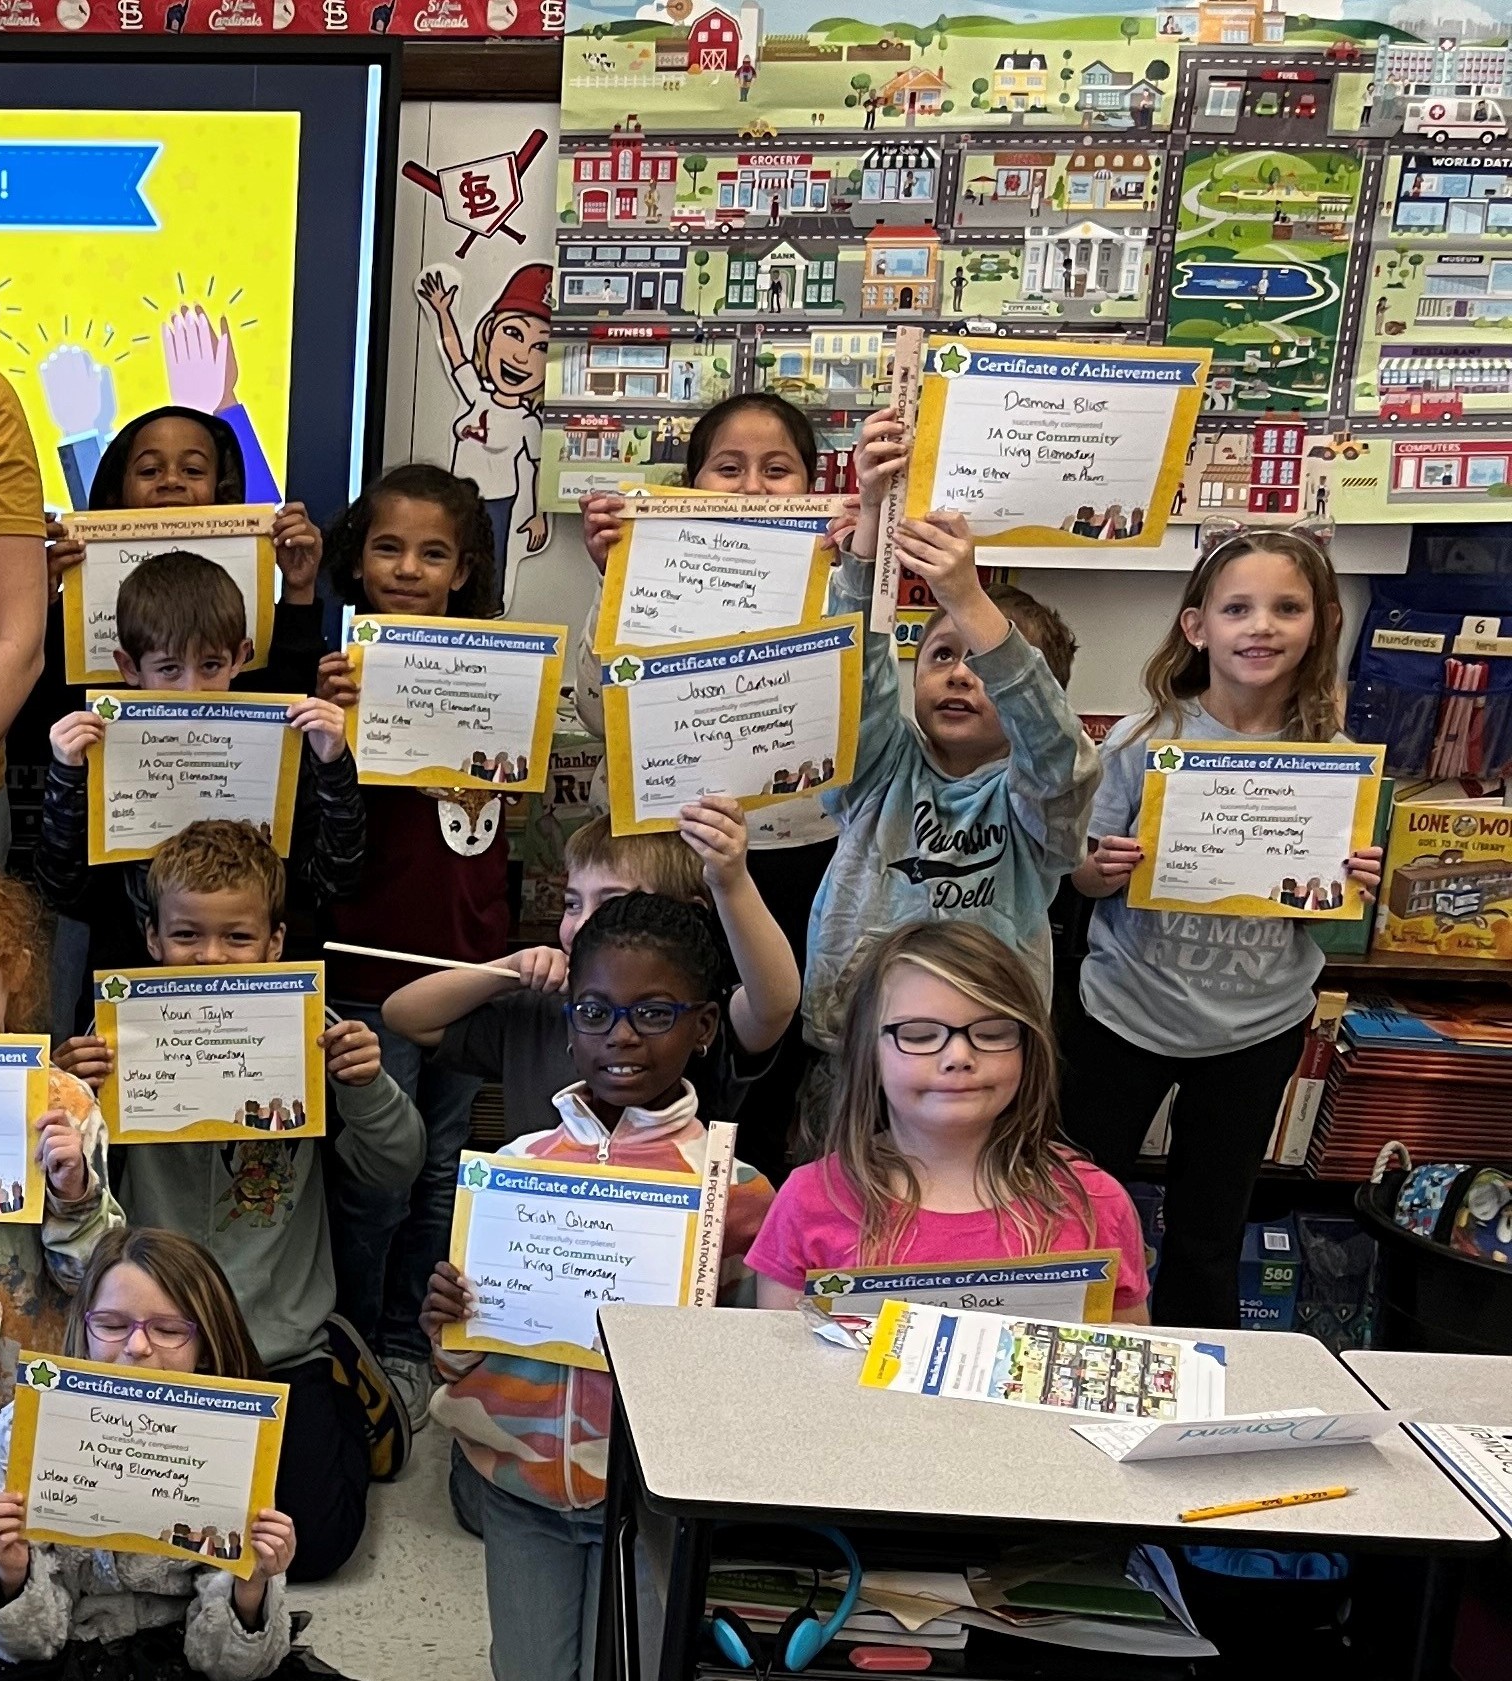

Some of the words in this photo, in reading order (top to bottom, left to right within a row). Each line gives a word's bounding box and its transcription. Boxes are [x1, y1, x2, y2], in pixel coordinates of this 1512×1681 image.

[209, 10, 263, 31] Cardinals
[413, 11, 468, 31] Cardinals
[750, 155, 800, 166] GROCERY
[1432, 157, 1479, 168] WORLD
[1483, 158, 1512, 169] DATA
[607, 327, 653, 337] FITNESS
[977, 357, 1058, 376] Certificate
[1060, 362, 1078, 376] of
[1079, 363, 1181, 381] Achievement
[987, 427, 1004, 441] JA
[1007, 430, 1033, 441] Our
[1036, 431, 1119, 445] Community
[1399, 443, 1460, 453] COMPUTERS
[651, 505, 692, 513] PEOPLES
[784, 504, 829, 512] KEWANEE
[1474, 620, 1485, 634] 6
[385, 630, 449, 644] Certificate
[451, 633, 465, 644] of
[465, 635, 545, 650] Achievement
[1377, 635, 1436, 649] hundreds
[650, 657, 728, 675] Certificate
[728, 650, 747, 663] of
[747, 634, 840, 661] Achievement
[126, 705, 188, 717] Certificate
[191, 706, 204, 717] of
[205, 707, 285, 720] Achievement
[1189, 756, 1256, 770] Certificate
[1258, 758, 1273, 769] of
[1274, 758, 1360, 772] Achievement
[1200, 812, 1214, 822] JA
[1216, 813, 1239, 822] Our
[1241, 813, 1312, 825] Community
[1409, 812, 1452, 834] LONE
[136, 983, 203, 994] Certificate
[205, 982, 218, 992] of
[219, 979, 304, 991] Achievement
[197, 1005, 234, 1027] Taylor
[156, 1037, 169, 1048] JA
[171, 1037, 193, 1047] Our
[195, 1036, 265, 1046] Community
[495, 1172, 569, 1194] Certificate
[570, 1178, 588, 1195] of
[588, 1181, 690, 1205] Achievement
[705, 1178, 717, 1227] PEOPLES
[508, 1241, 523, 1252] JA
[526, 1243, 550, 1255] Our
[552, 1245, 635, 1267] Community
[698, 1229, 712, 1279] NATIONAL
[862, 1276, 951, 1290] Certificate
[955, 1273, 972, 1284] of
[975, 1265, 1091, 1285] Achievement
[1264, 1268, 1293, 1282] 580
[959, 1293, 1005, 1308] Black
[66, 1375, 143, 1400] Certificate
[146, 1386, 163, 1400] of
[164, 1390, 262, 1412] Achievement
[90, 1406, 134, 1437] Everly
[79, 1440, 95, 1452] JA
[97, 1443, 123, 1456] Our
[125, 1447, 207, 1469] Community
[92, 1455, 124, 1479] Irving
[129, 1462, 190, 1487] Elementary
